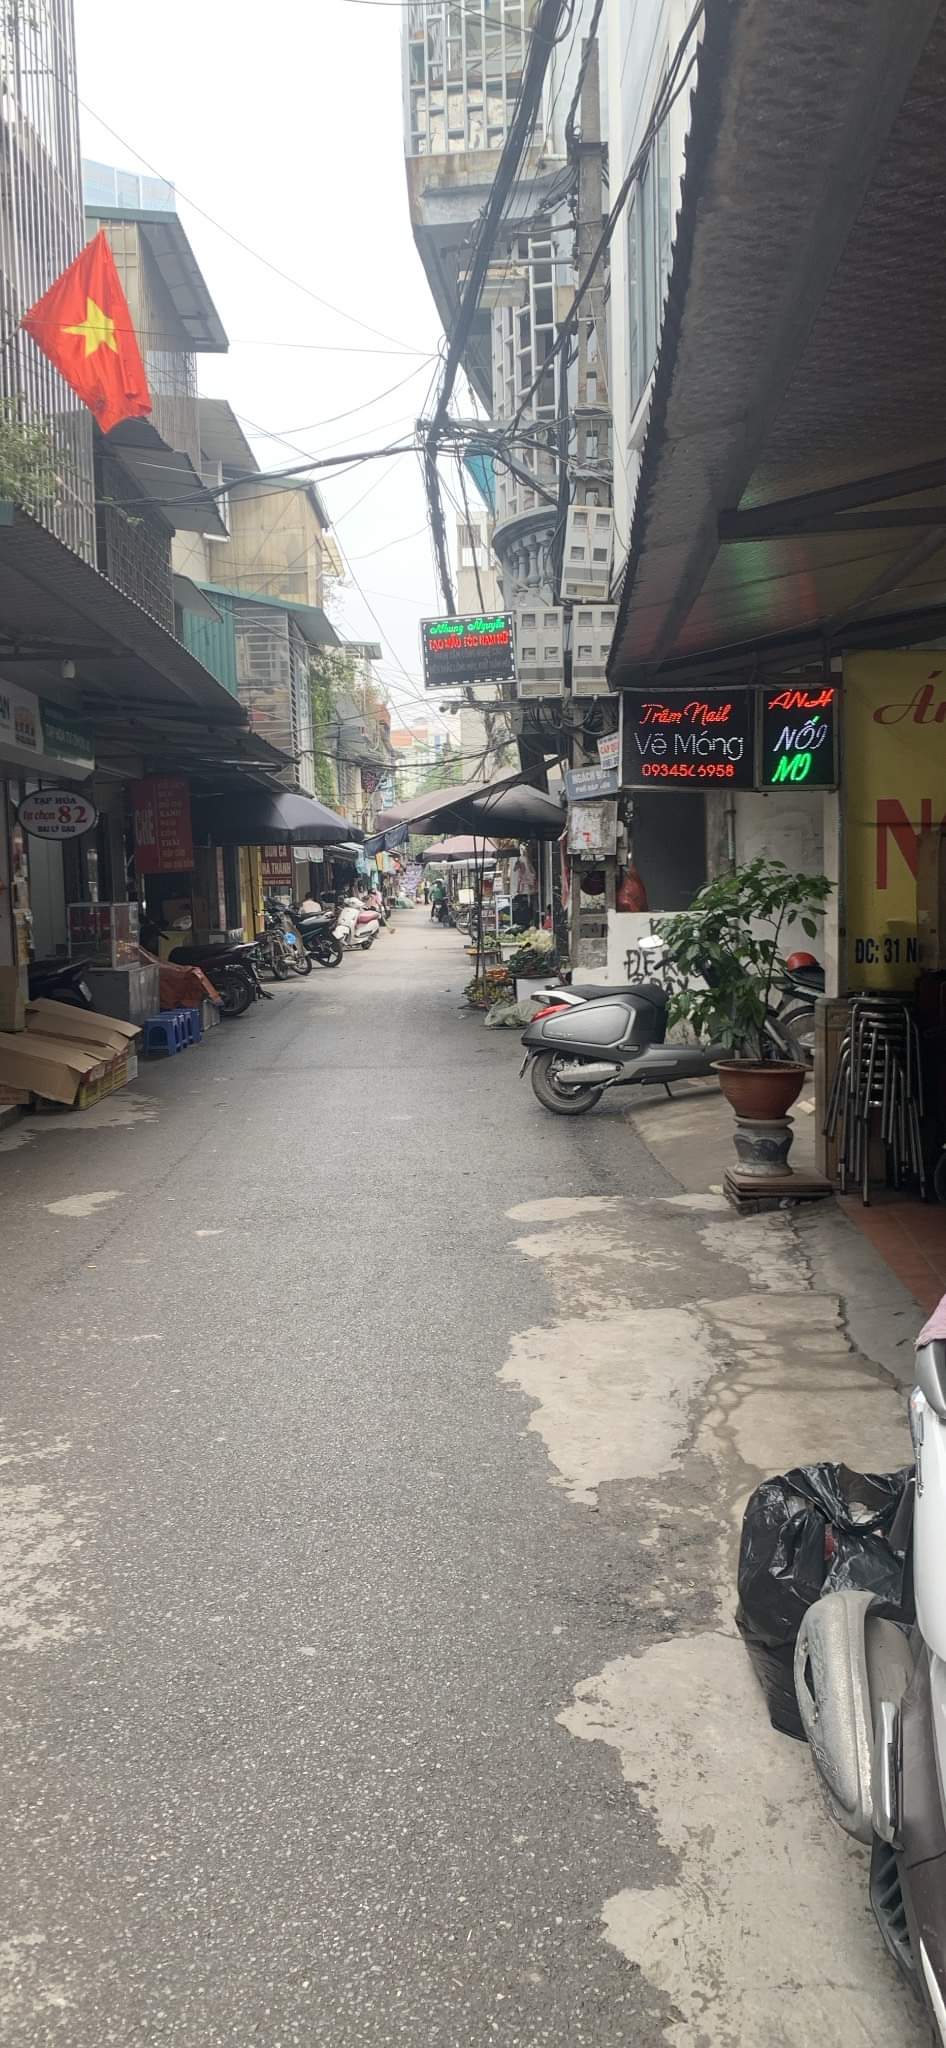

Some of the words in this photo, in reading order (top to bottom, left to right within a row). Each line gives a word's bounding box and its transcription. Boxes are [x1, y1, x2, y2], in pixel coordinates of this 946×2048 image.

[639, 703, 682, 725] Trâm
[684, 702, 732, 726] Nail
[633, 732, 667, 755] Vẽ
[674, 730, 744, 761] Móng
[58, 805, 87, 824] 82
[884, 938, 900, 964] 31
